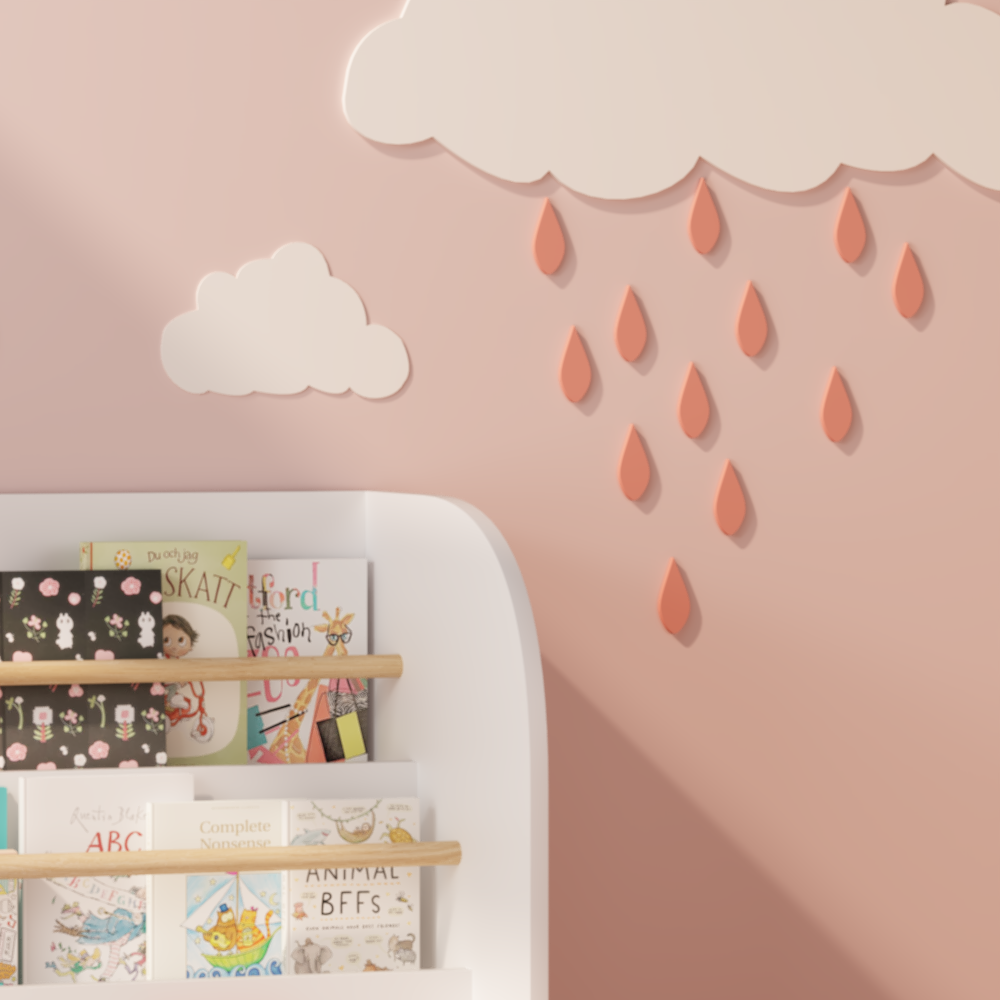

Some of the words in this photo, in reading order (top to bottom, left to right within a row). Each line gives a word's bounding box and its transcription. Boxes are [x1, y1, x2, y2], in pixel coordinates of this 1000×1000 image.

[163, 566, 241, 609] SKATT
[199, 819, 272, 837] Complete
[86, 830, 143, 853] ABC
[320, 890, 381, 916] BFFs
